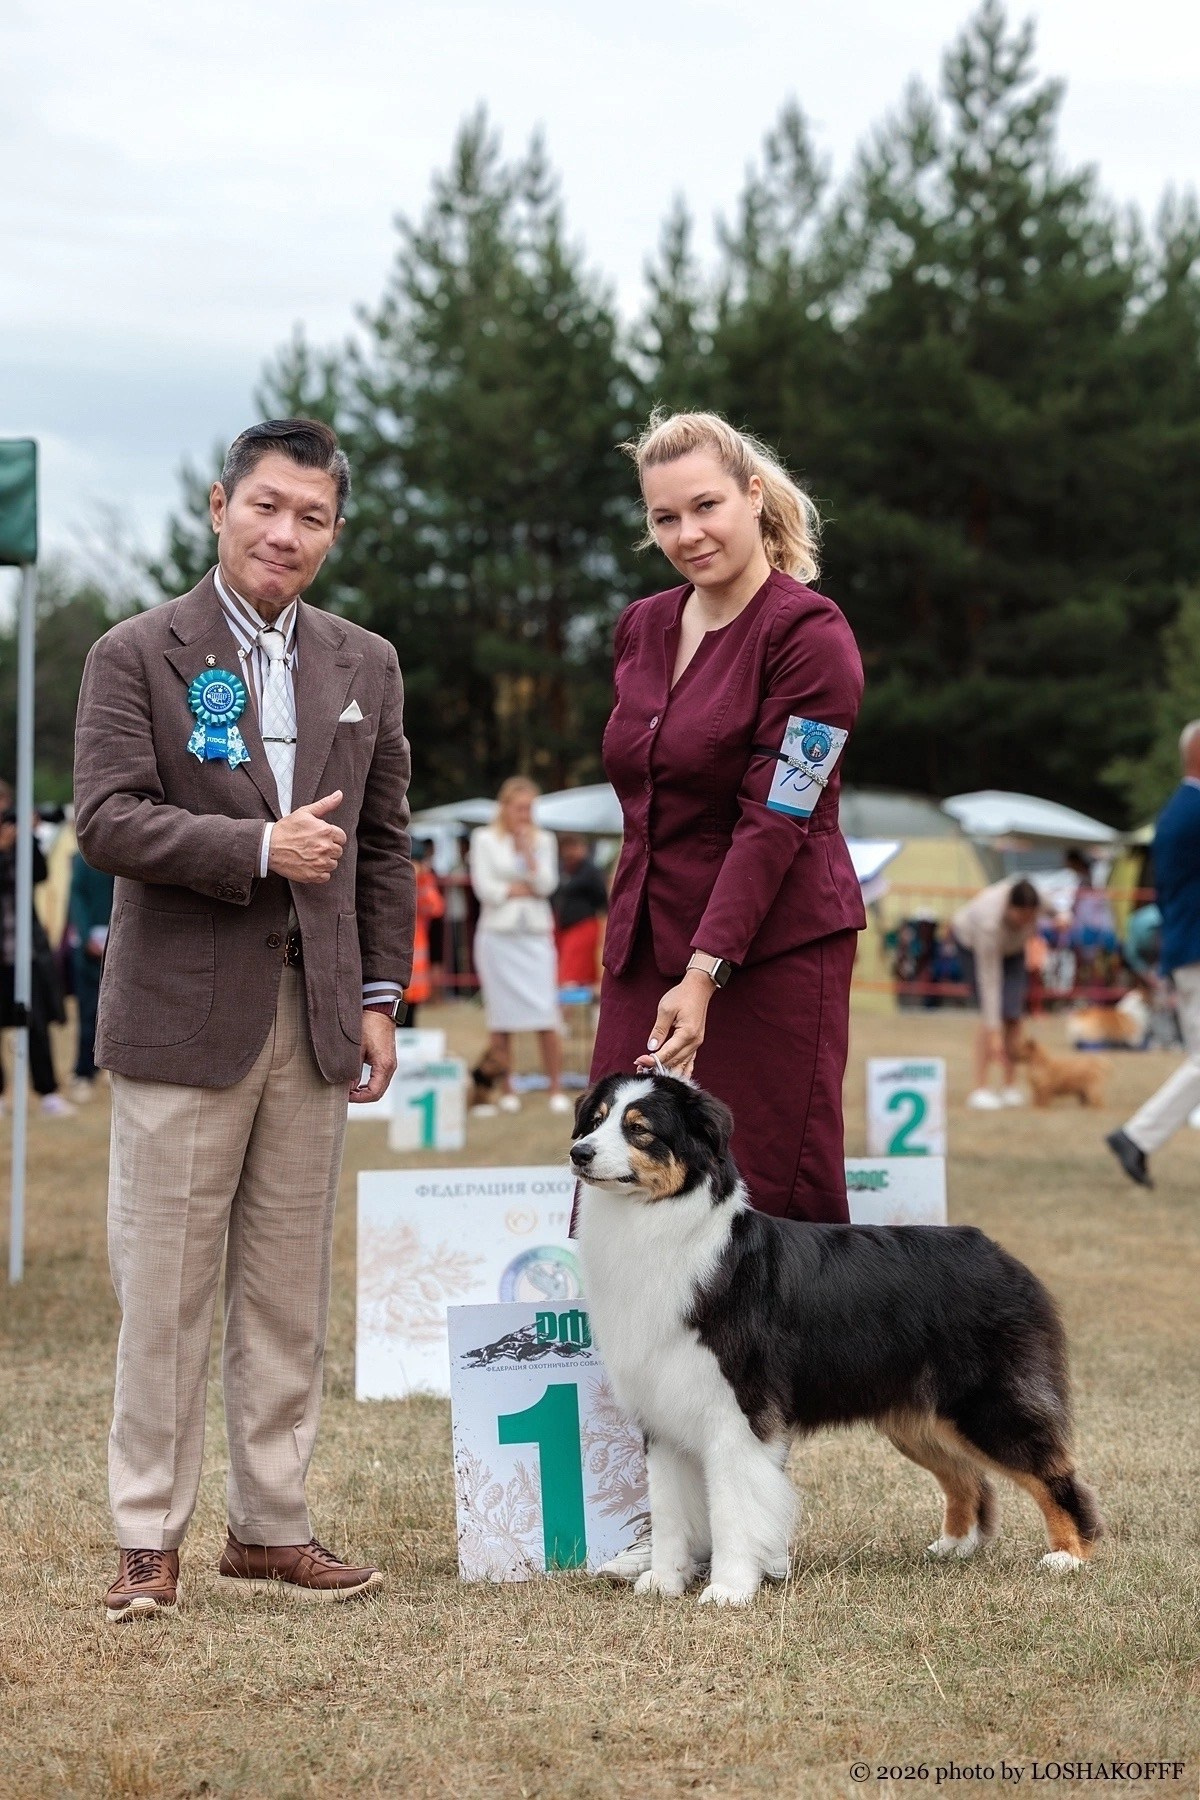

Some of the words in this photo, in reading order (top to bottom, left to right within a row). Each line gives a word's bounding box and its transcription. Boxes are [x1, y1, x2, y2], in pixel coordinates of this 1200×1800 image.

[409, 1088, 435, 1149] 1
[886, 1089, 930, 1157] 2
[415, 1182, 526, 1197] ФЕДЕРАЦИЯ
[486, 1364, 527, 1372] ФЕДЕРАЦИЯ
[528, 1360, 579, 1370] ОХОТНИЧЬЕГО
[497, 1383, 587, 1571] 1
